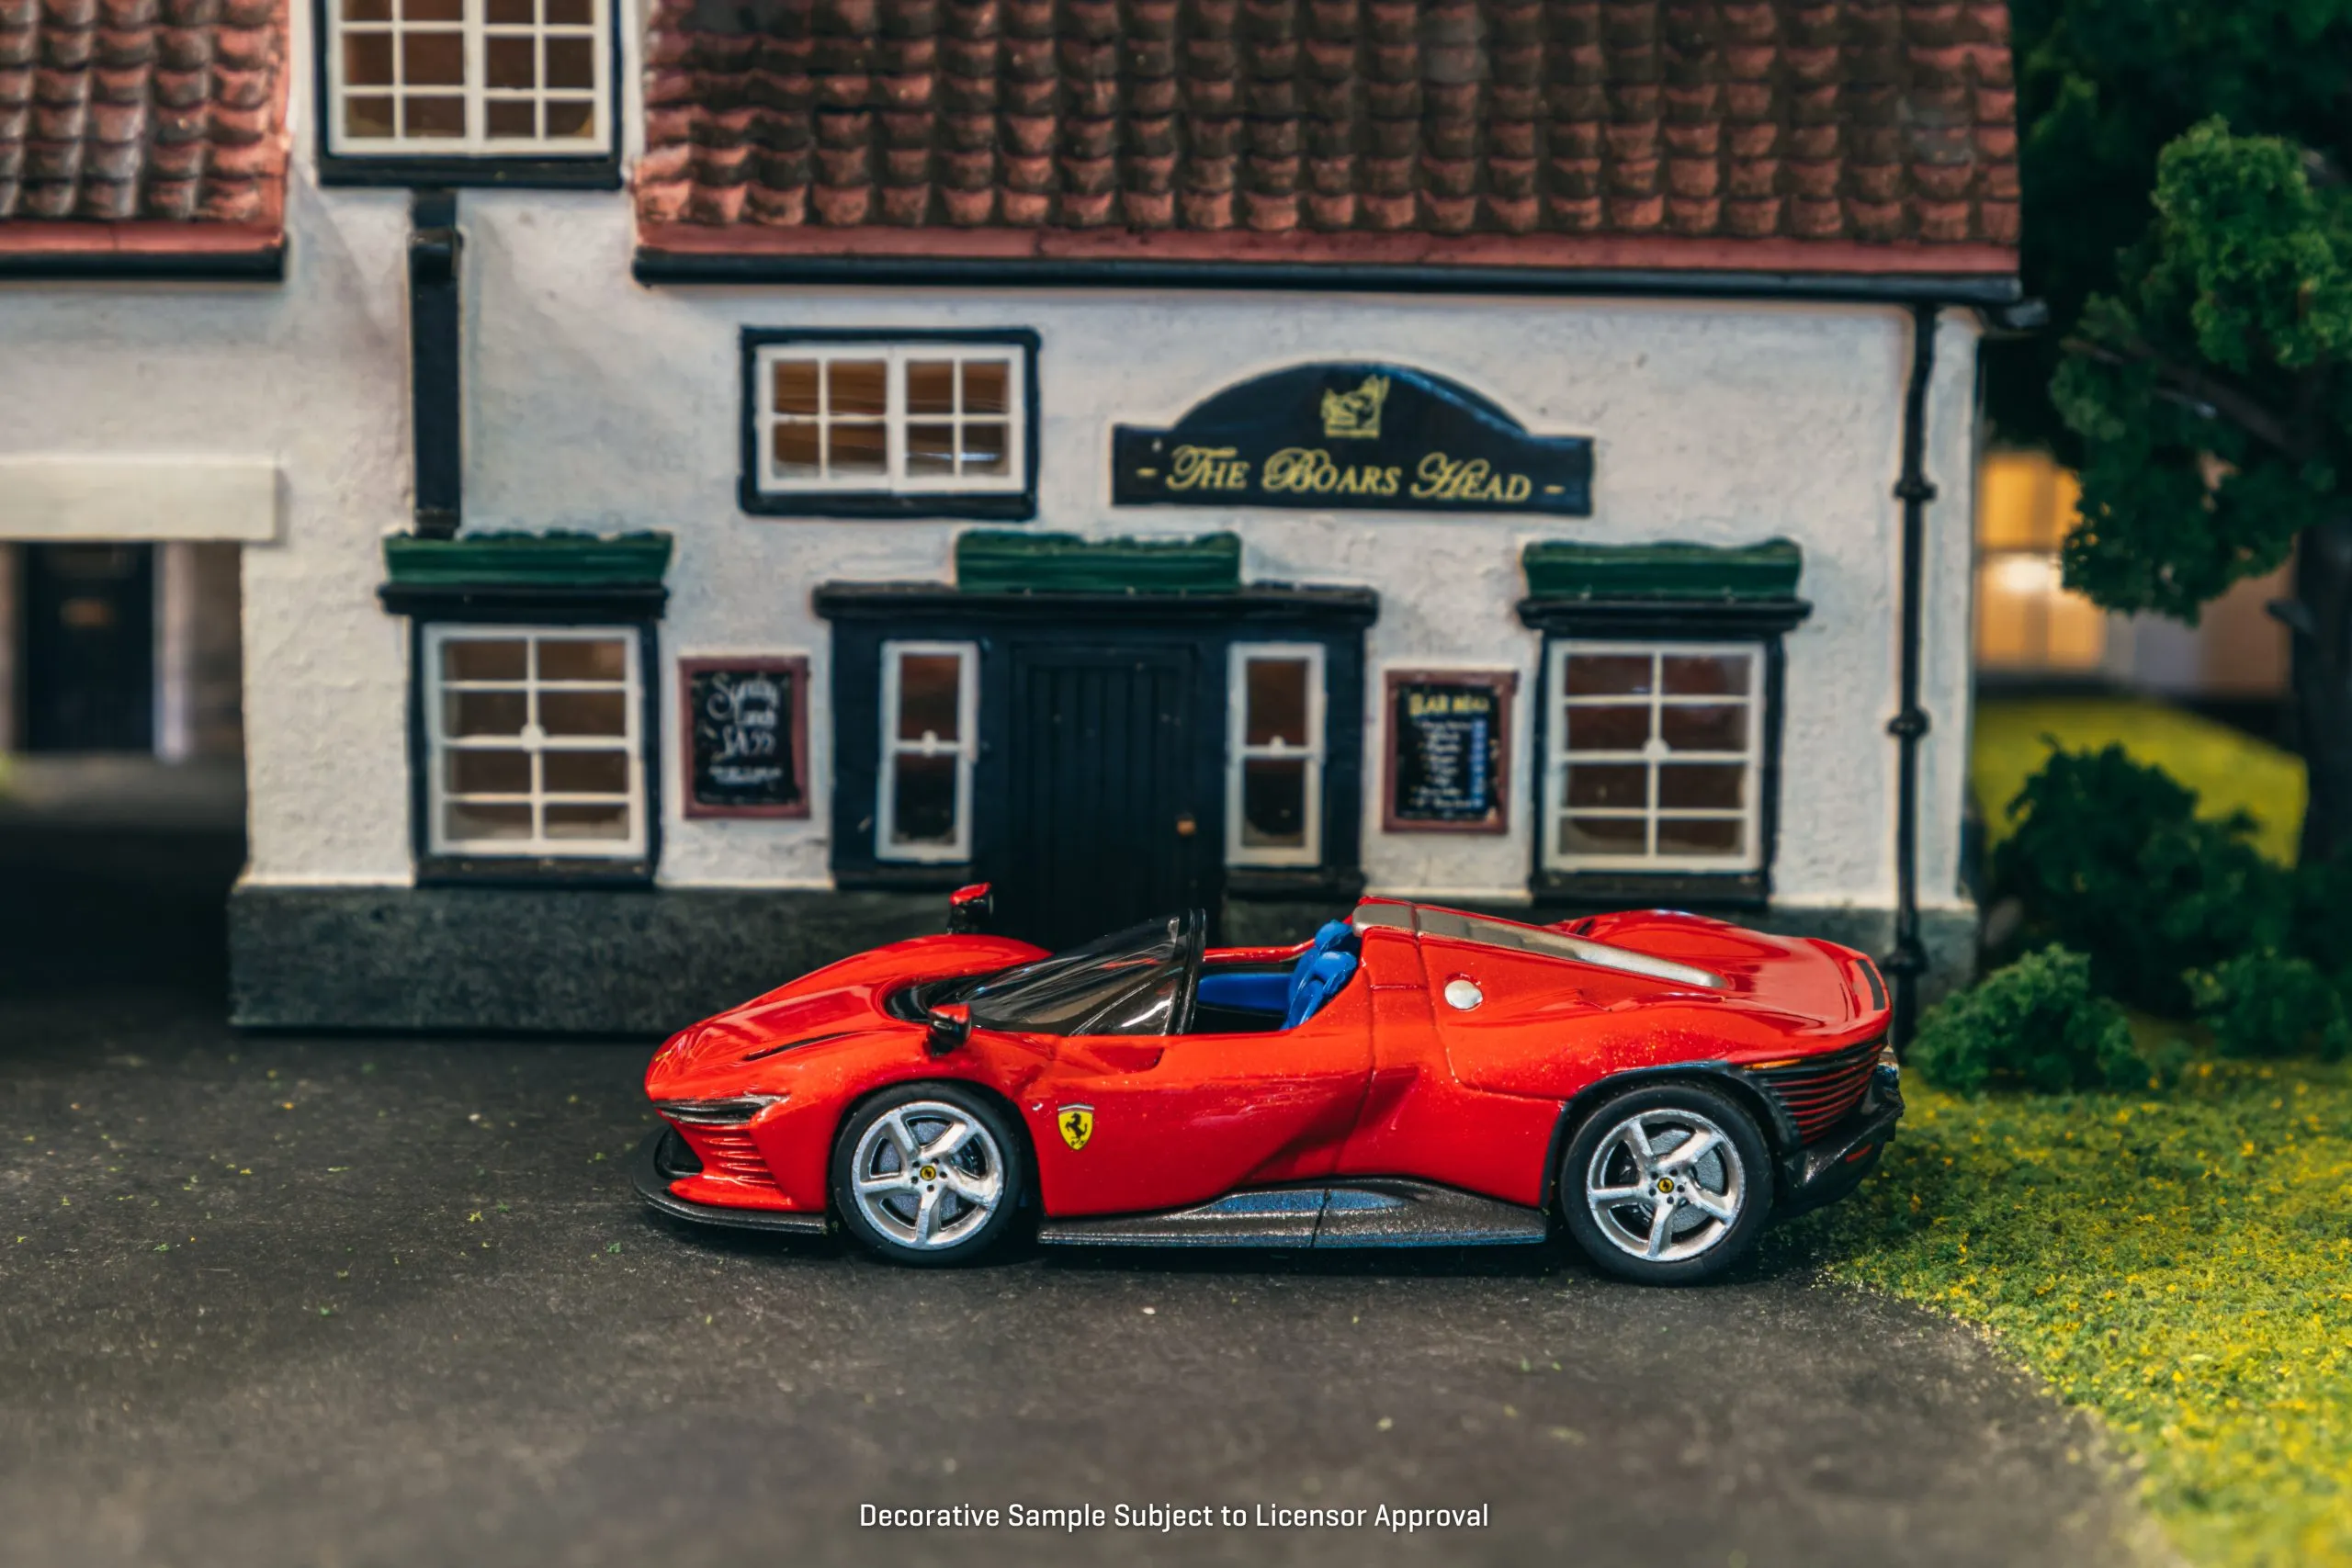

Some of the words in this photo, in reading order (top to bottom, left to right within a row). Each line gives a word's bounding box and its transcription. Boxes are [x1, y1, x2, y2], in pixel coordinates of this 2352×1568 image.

[1165, 445, 1251, 491] THE
[1261, 446, 1402, 495] BOARS
[1409, 451, 1532, 502] HEAD
